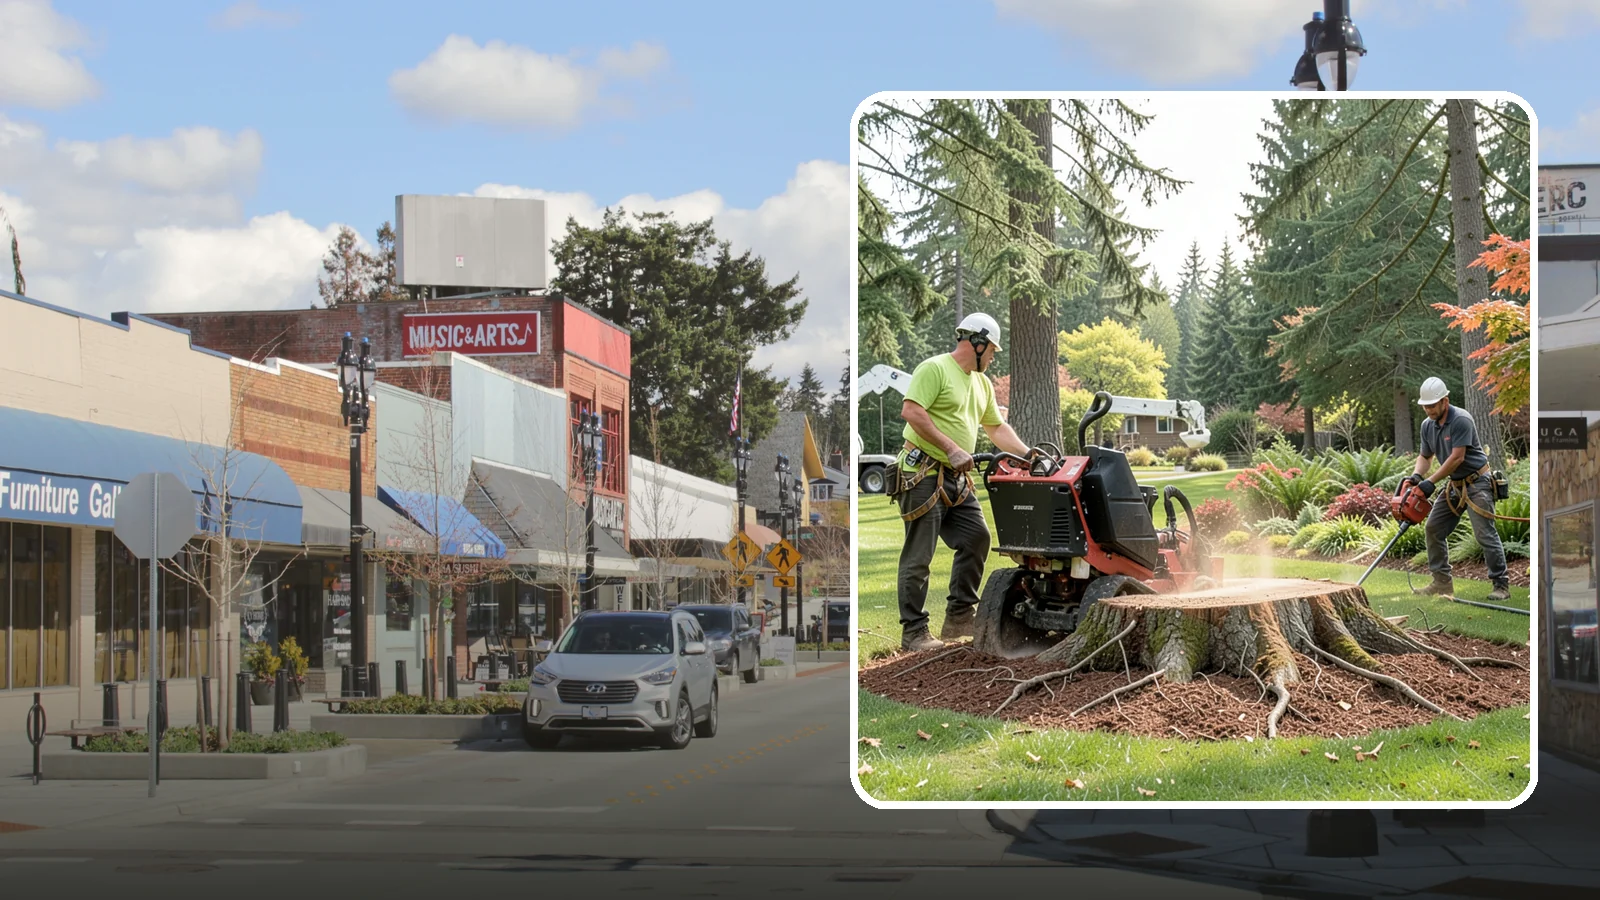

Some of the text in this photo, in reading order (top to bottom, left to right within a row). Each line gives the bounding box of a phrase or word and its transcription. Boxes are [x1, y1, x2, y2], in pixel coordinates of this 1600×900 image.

[408, 323, 520, 349] MUSIC&ARTS
[1540, 428, 1578, 436] UGA
[0, 471, 122, 519] Furniture Gal
[453, 563, 480, 574] SUSHI
